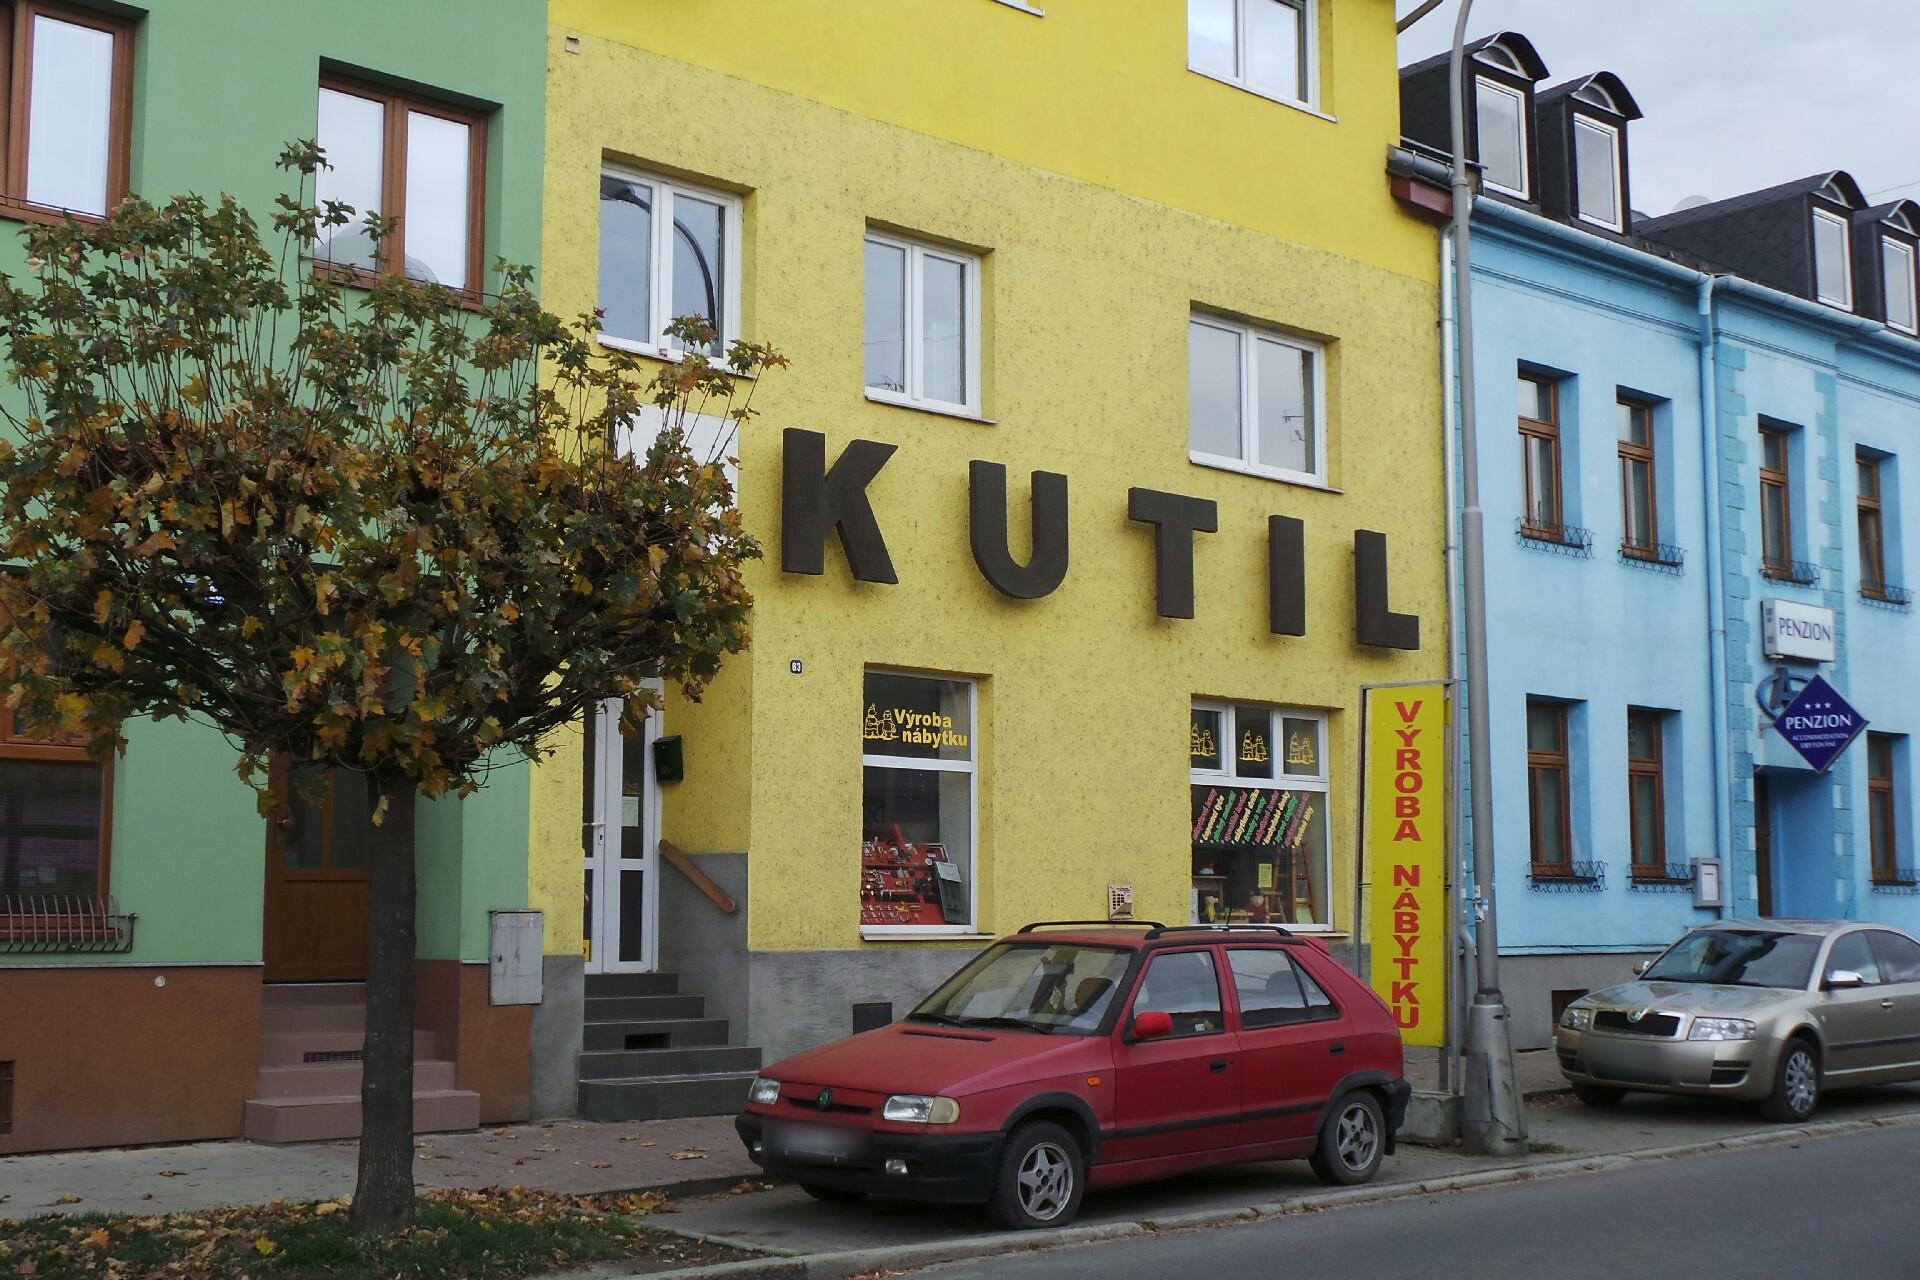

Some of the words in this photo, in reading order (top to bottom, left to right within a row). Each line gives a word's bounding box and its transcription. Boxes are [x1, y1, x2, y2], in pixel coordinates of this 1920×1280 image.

[782, 427, 1420, 651] KUTIL
[1778, 617, 1831, 641] PENZION
[894, 708, 952, 728] Výroba
[1785, 714, 1852, 730] PENZION
[902, 728, 968, 749] nábytku
[1392, 700, 1424, 842] VÝROBA
[1391, 864, 1421, 1029] NÁBYTKU
